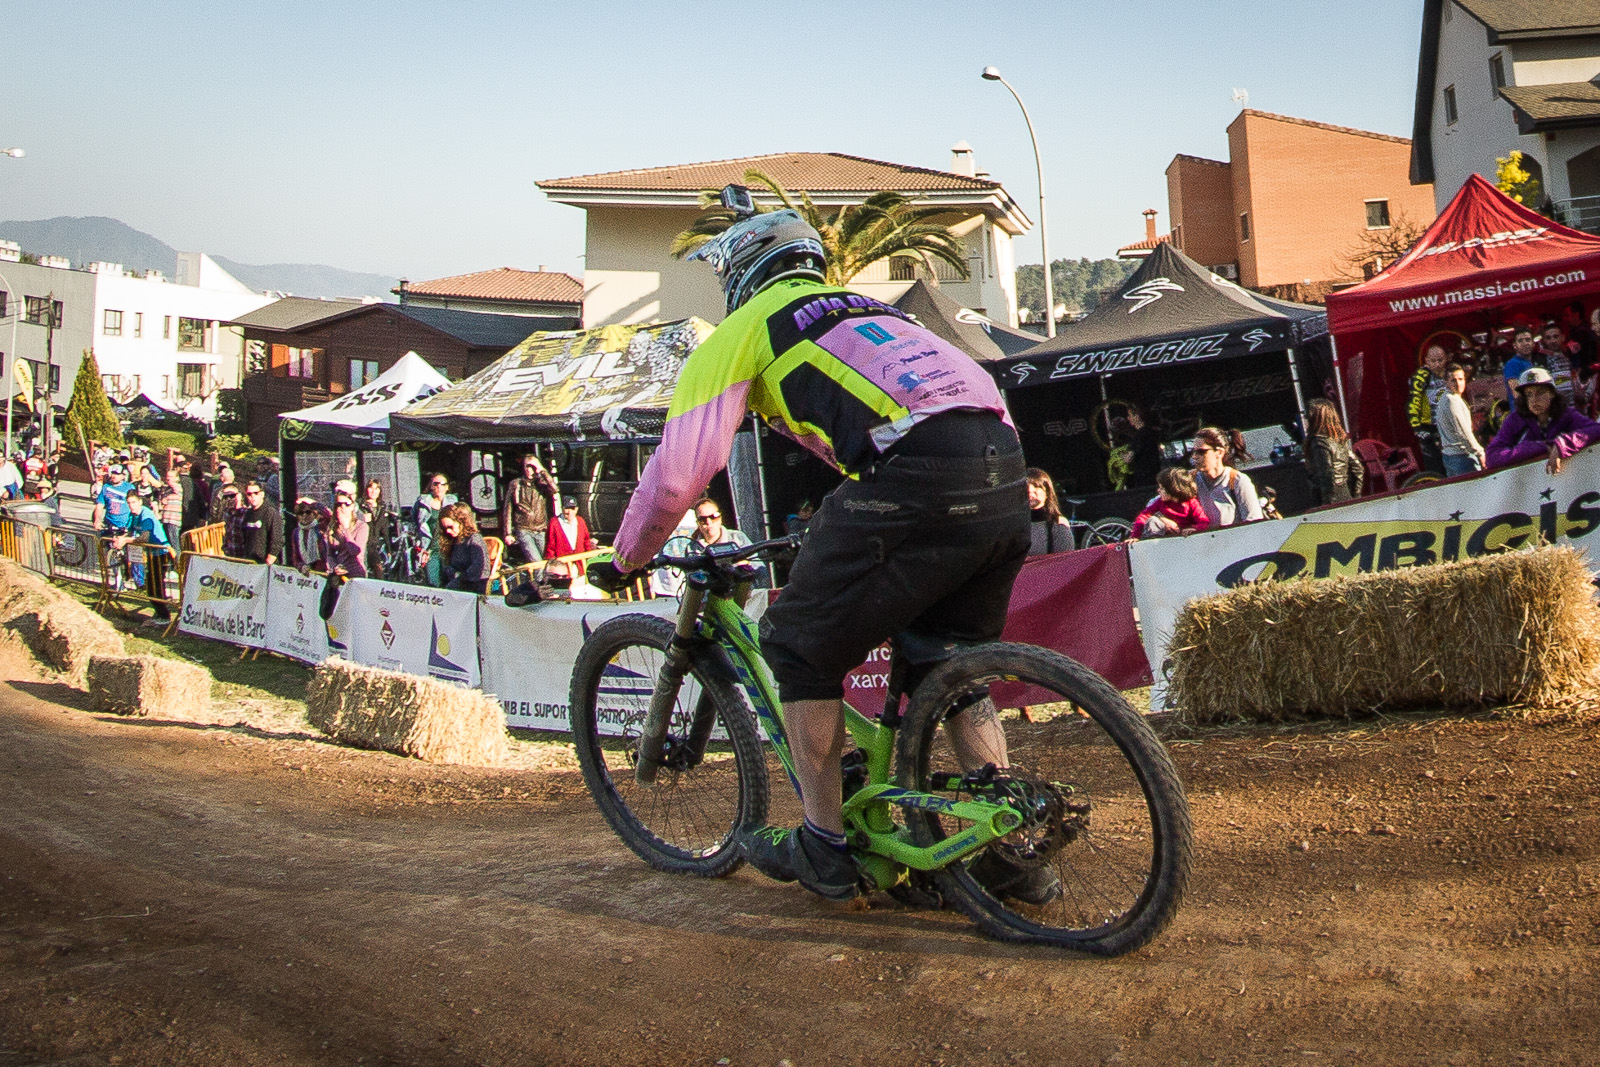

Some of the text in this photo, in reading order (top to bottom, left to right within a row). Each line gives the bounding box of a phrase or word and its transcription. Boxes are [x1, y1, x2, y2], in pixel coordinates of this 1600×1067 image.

[1388, 269, 1586, 313] www.massi-cm.com
[490, 352, 636, 393] EVIL
[520, 701, 532, 717] EL
[534, 702, 571, 720] SUPOR
